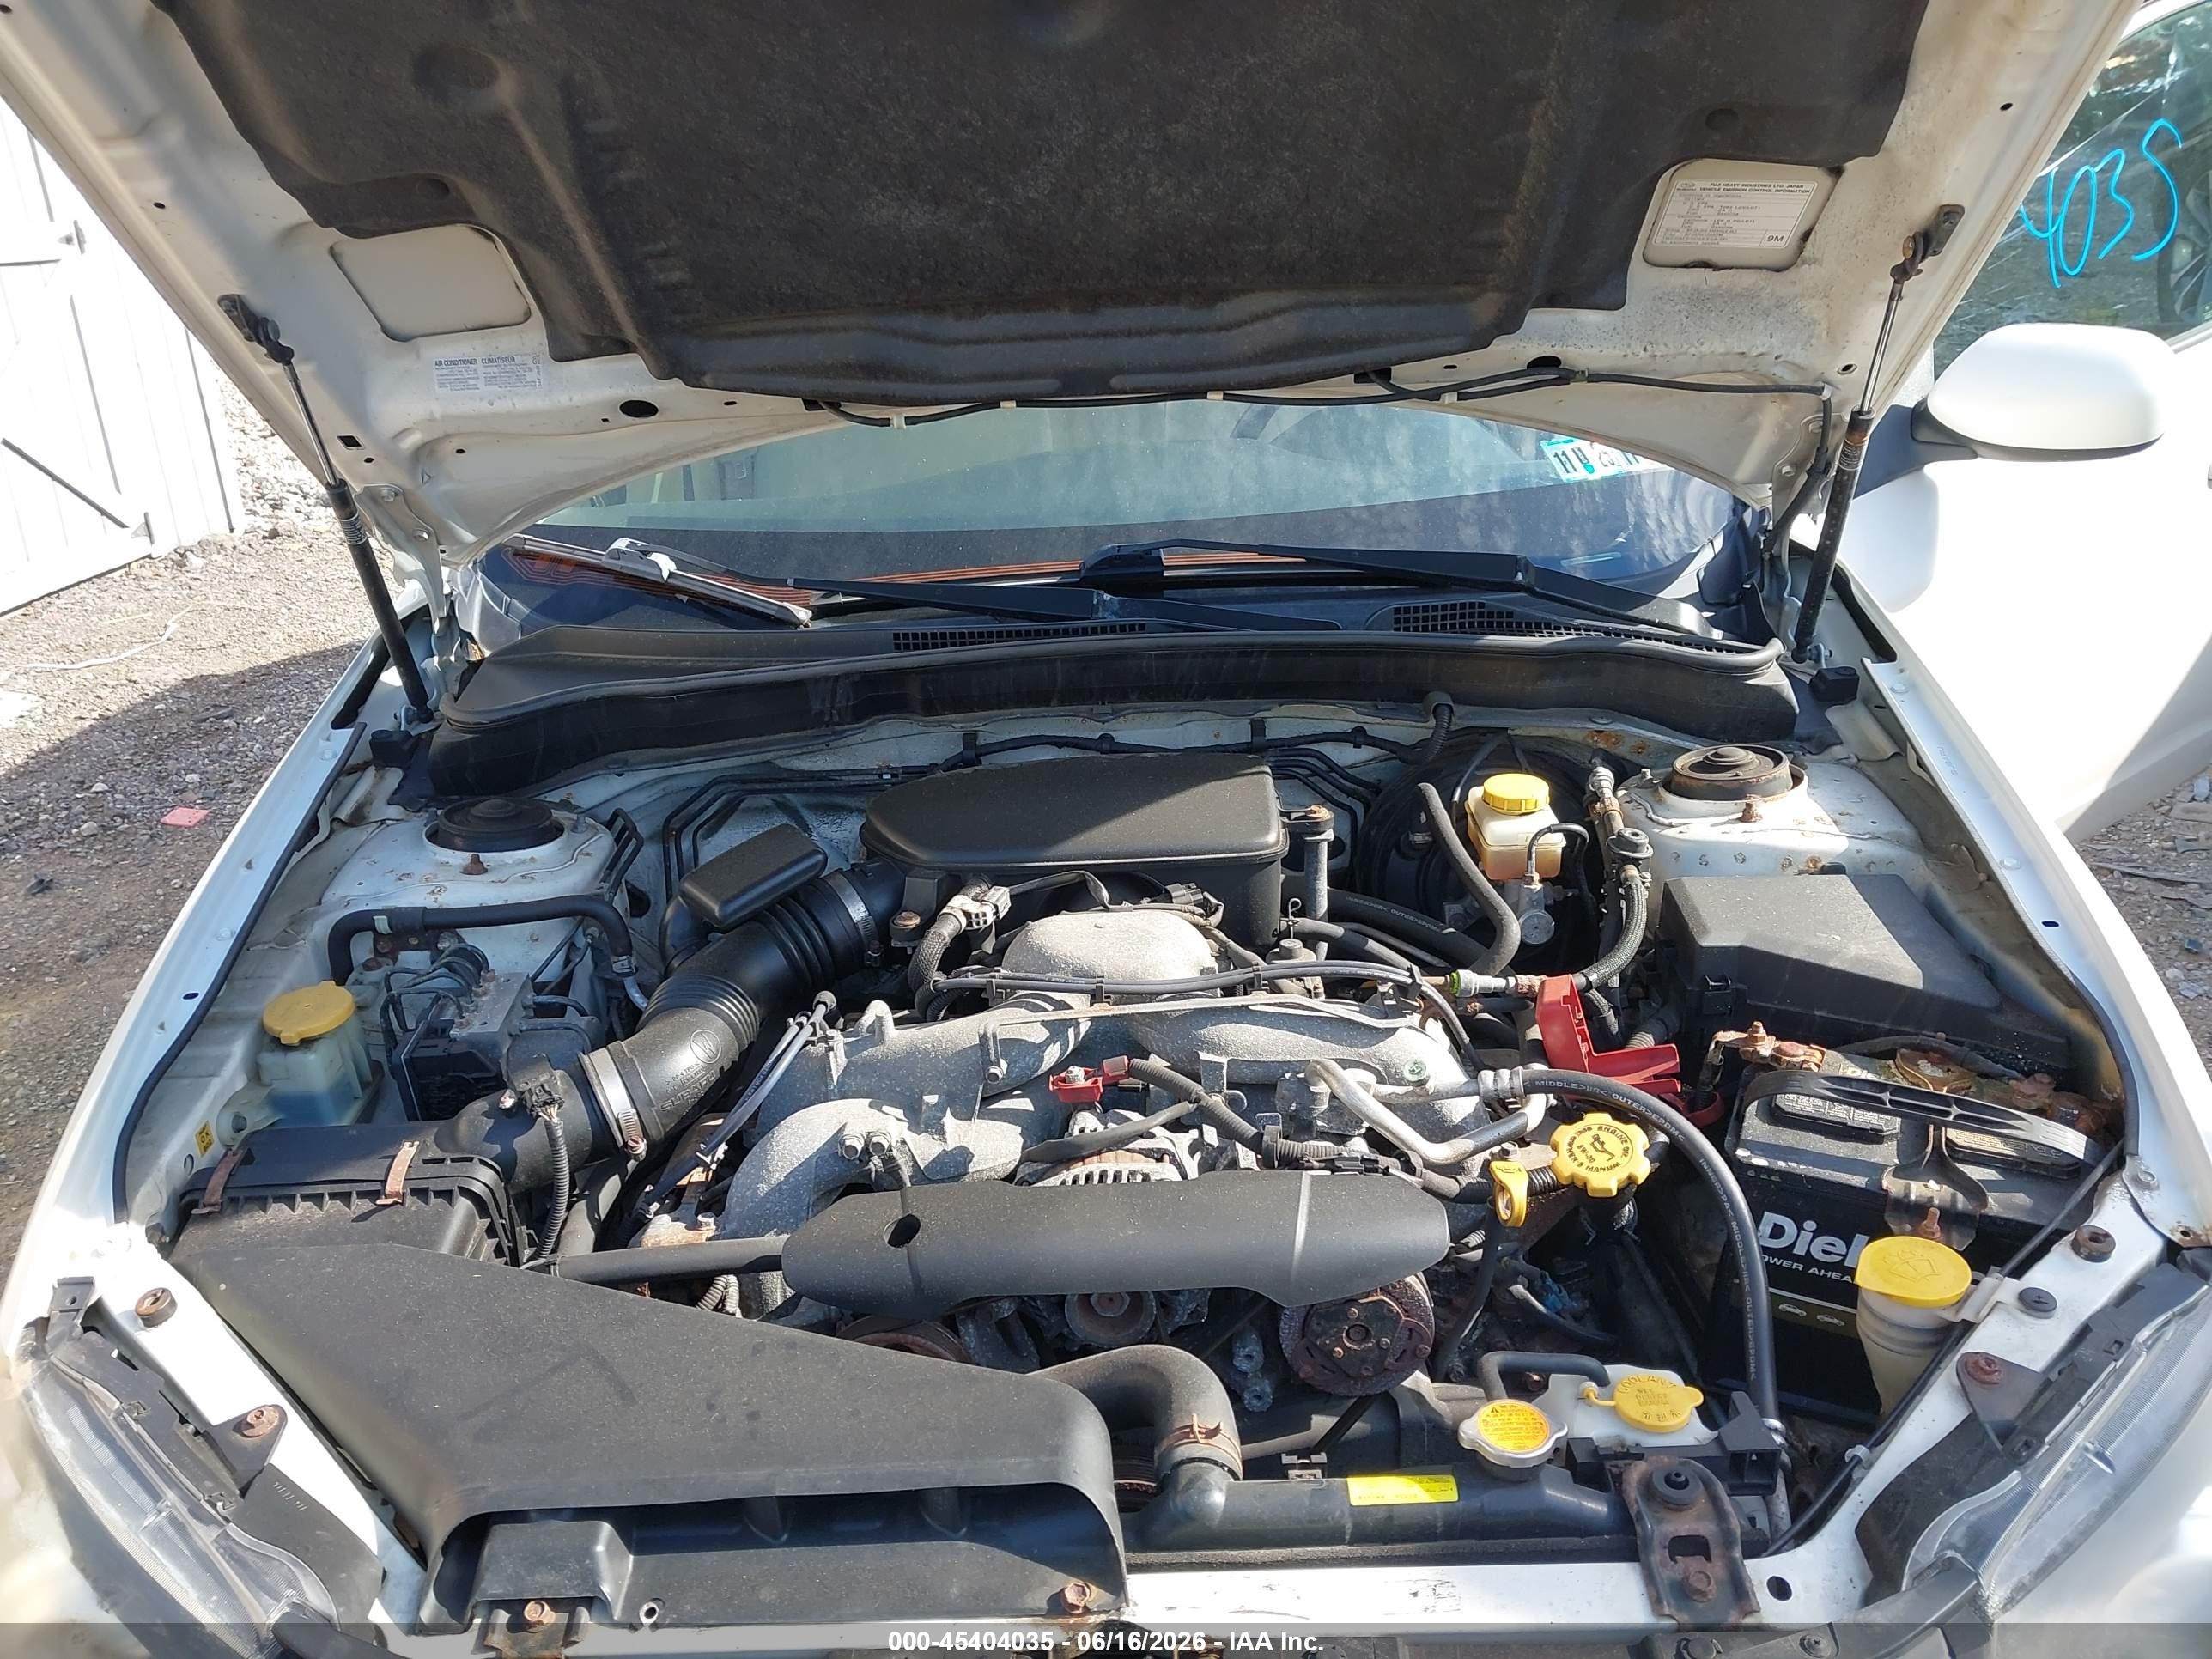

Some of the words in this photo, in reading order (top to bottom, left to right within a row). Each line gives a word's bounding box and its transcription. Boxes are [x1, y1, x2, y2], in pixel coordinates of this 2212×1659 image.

[1765, 234, 1785, 243] 9M
[443, 358, 478, 366] CONDITIONER
[481, 356, 515, 365] CLIMATISEUR
[1597, 1125, 1628, 1146] ENGINE
[1586, 1162, 1622, 1173] MANUAL
[1808, 1267, 1857, 1285] AHEA
[1618, 1374, 1678, 1395] COOLANT
